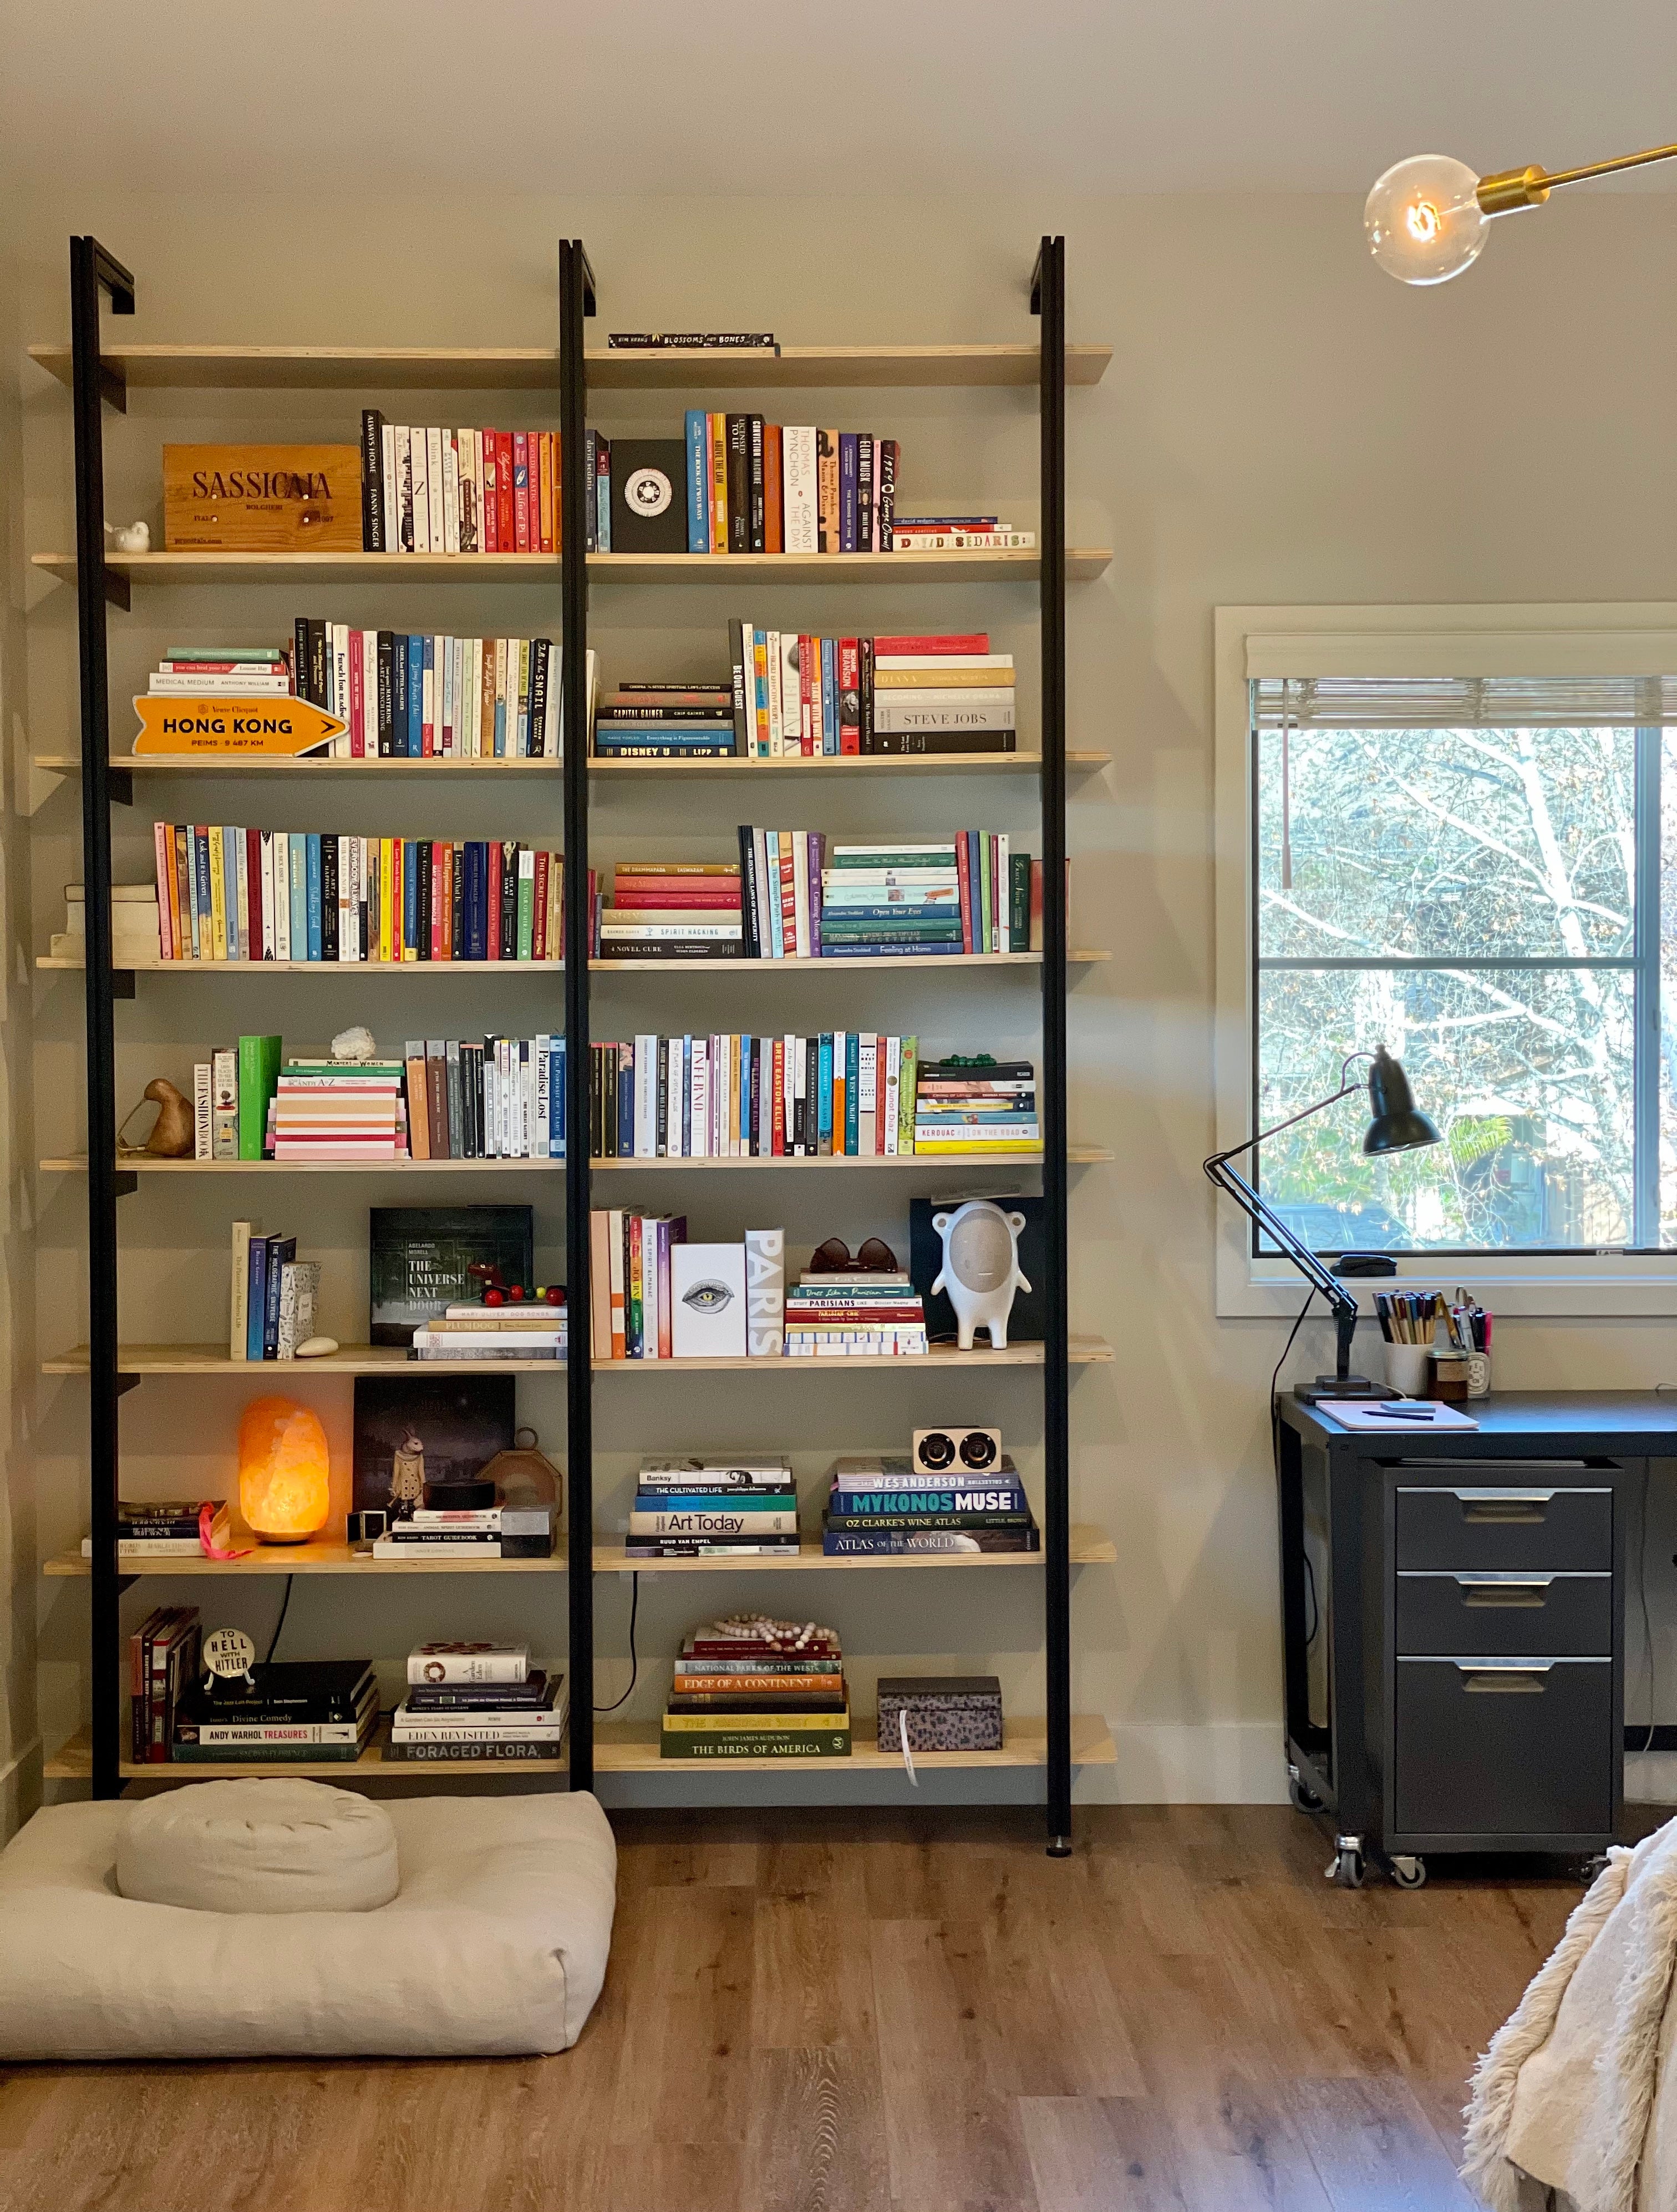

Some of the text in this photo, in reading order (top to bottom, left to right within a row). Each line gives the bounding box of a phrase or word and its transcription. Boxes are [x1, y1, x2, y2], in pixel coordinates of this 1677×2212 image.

[732, 423, 739, 435] TO
[753, 421, 761, 484] CONVICTION MACHINE
[789, 429, 799, 486] PYNCHON
[800, 430, 810, 475] THOMAS
[715, 440, 724, 484] ABOVE THE LAW
[860, 441, 871, 481] ELON MUSK
[883, 455, 893, 481] 1984
[518, 511, 525, 520] of
[882, 496, 893, 549] George Orwell
[519, 524, 525, 533] Pi
[790, 505, 800, 548] THE DAY
[802, 503, 811, 549] AGAINST
[842, 649, 851, 687] BRANSON
[733, 665, 744, 709] BE OUR GUEST
[613, 709, 663, 718] CAPITAL GAINES
[904, 713, 987, 725] STEVE JOBS
[163, 719, 292, 734] HONG KONG
[453, 854, 461, 876] Loving
[538, 1050, 548, 1119] Paradise Lost
[694, 1050, 704, 1110] INFERNO
[408, 1260, 431, 1271] THE
[409, 1274, 465, 1285] UNIVERSE
[632, 1267, 640, 1307] JOURNAL
[409, 1287, 438, 1298] NEXT
[748, 1230, 784, 1356] PARIS
[409, 1300, 441, 1311] DOOR
[873, 1476, 965, 1488] WES ANDERSON
[852, 1492, 1012, 1513] MYKONOS MUSE
[668, 1514, 744, 1533] Art Today
[863, 1519, 905, 1527] CLARKE'S
[835, 1539, 874, 1550] ATLAS
[906, 1539, 954, 1549] WORLD
[211, 1638, 247, 1652] HELL
[215, 1657, 248, 1672] HITLER
[684, 1679, 813, 1689] EDGE OF A CONTINENT
[260, 1714, 292, 1723] Comedy
[210, 1730, 308, 1739] ANDY WARHOL TREASURES
[409, 1731, 500, 1741] EDEN REVISITED
[693, 1746, 715, 1754] THE
[718, 1746, 749, 1754] BIRDS
[771, 1745, 820, 1754] AMERICA
